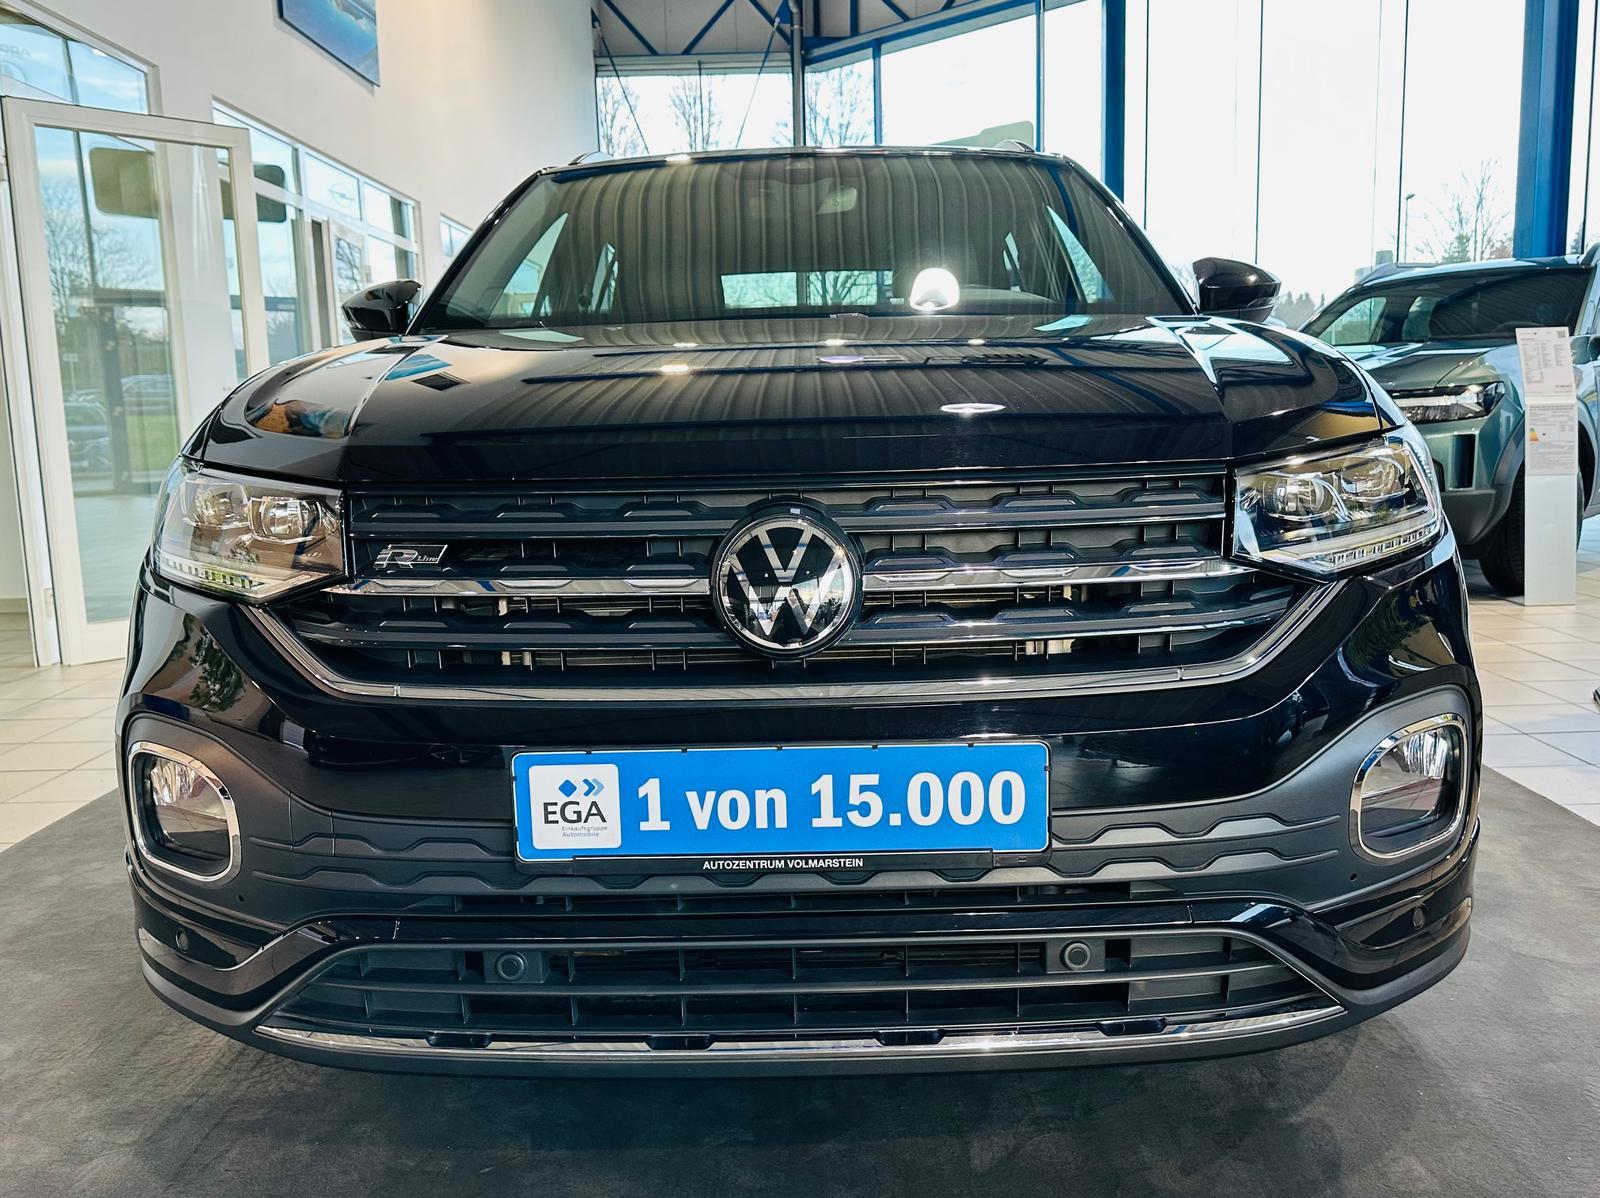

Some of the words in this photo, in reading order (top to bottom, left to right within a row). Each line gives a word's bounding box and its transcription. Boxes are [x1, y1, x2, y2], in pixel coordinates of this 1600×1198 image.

[722, 522, 849, 641] VW
[543, 800, 607, 824] EGA
[637, 778, 670, 831] 1
[685, 787, 787, 831] von
[810, 771, 1026, 828] 15.000
[702, 859, 785, 870] AUTOZENTRUM
[786, 858, 863, 868] VOLMARSTEIN
